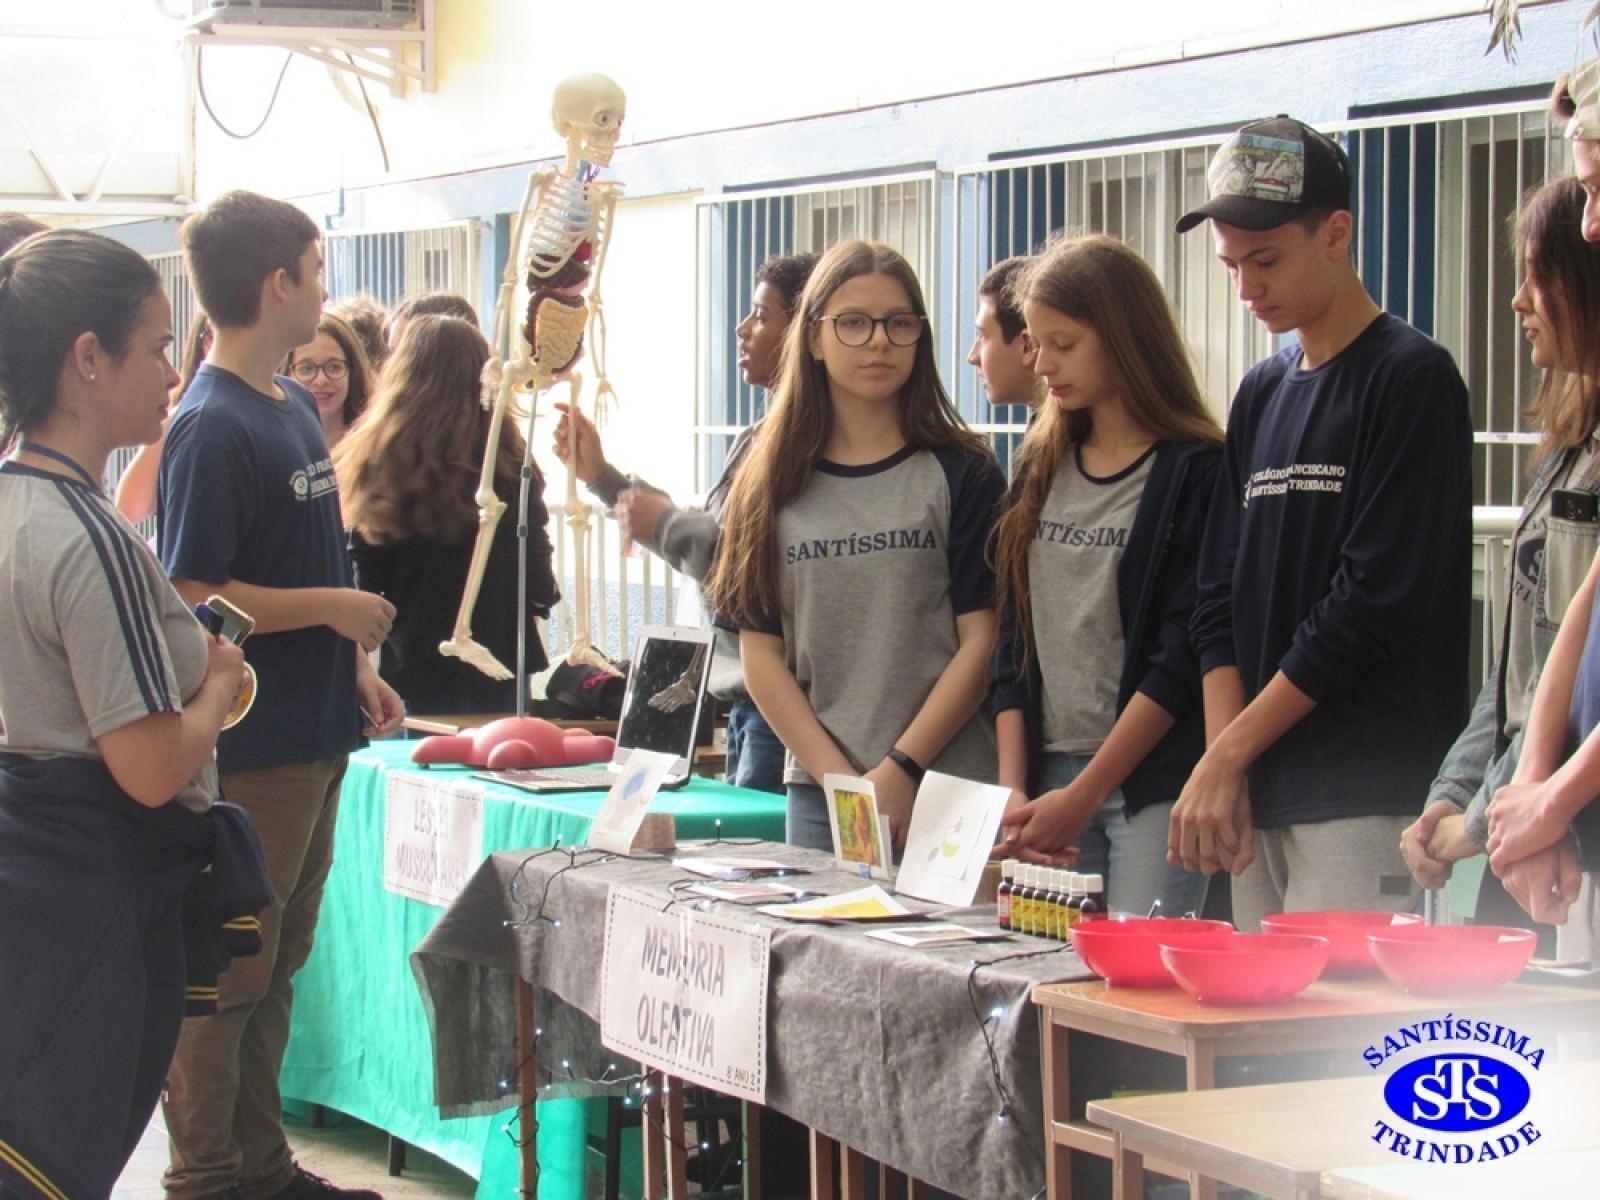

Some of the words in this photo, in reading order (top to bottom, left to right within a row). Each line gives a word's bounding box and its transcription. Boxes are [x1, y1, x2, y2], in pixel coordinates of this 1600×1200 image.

[786, 529, 937, 565] SANTÍSSIMA
[1033, 520, 1129, 548] NTÍSSIM
[637, 992, 715, 1068] OLFATIVA
